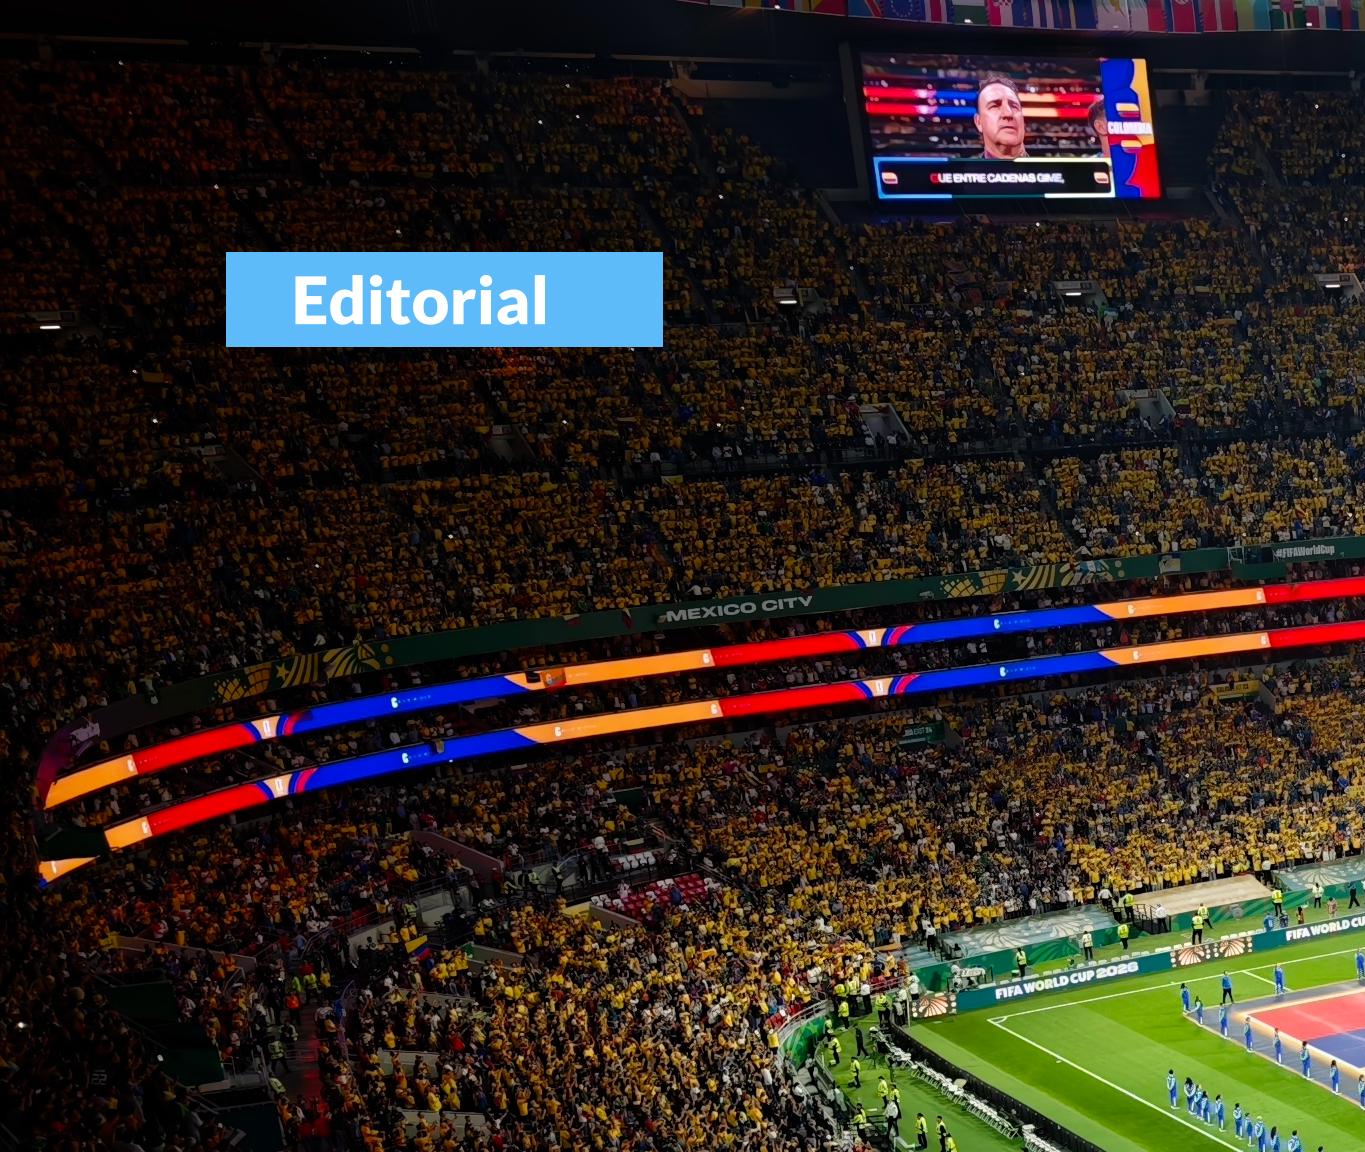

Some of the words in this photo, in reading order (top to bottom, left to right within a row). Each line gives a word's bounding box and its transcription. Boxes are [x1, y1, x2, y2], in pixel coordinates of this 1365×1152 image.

[953, 173, 987, 184] ENTRE
[987, 173, 1036, 184] CADENAS
[1275, 545, 1335, 558] #FIFAWorldCup
[666, 602, 757, 622] MEXICO
[761, 596, 812, 612] CITY
[1286, 929, 1311, 941] FIFA
[1311, 919, 1350, 936] WORLD
[995, 985, 1024, 1000] FIFA
[1024, 977, 1069, 994] WORLD
[1070, 971, 1095, 984] CUP
[1096, 962, 1139, 978] 2026
